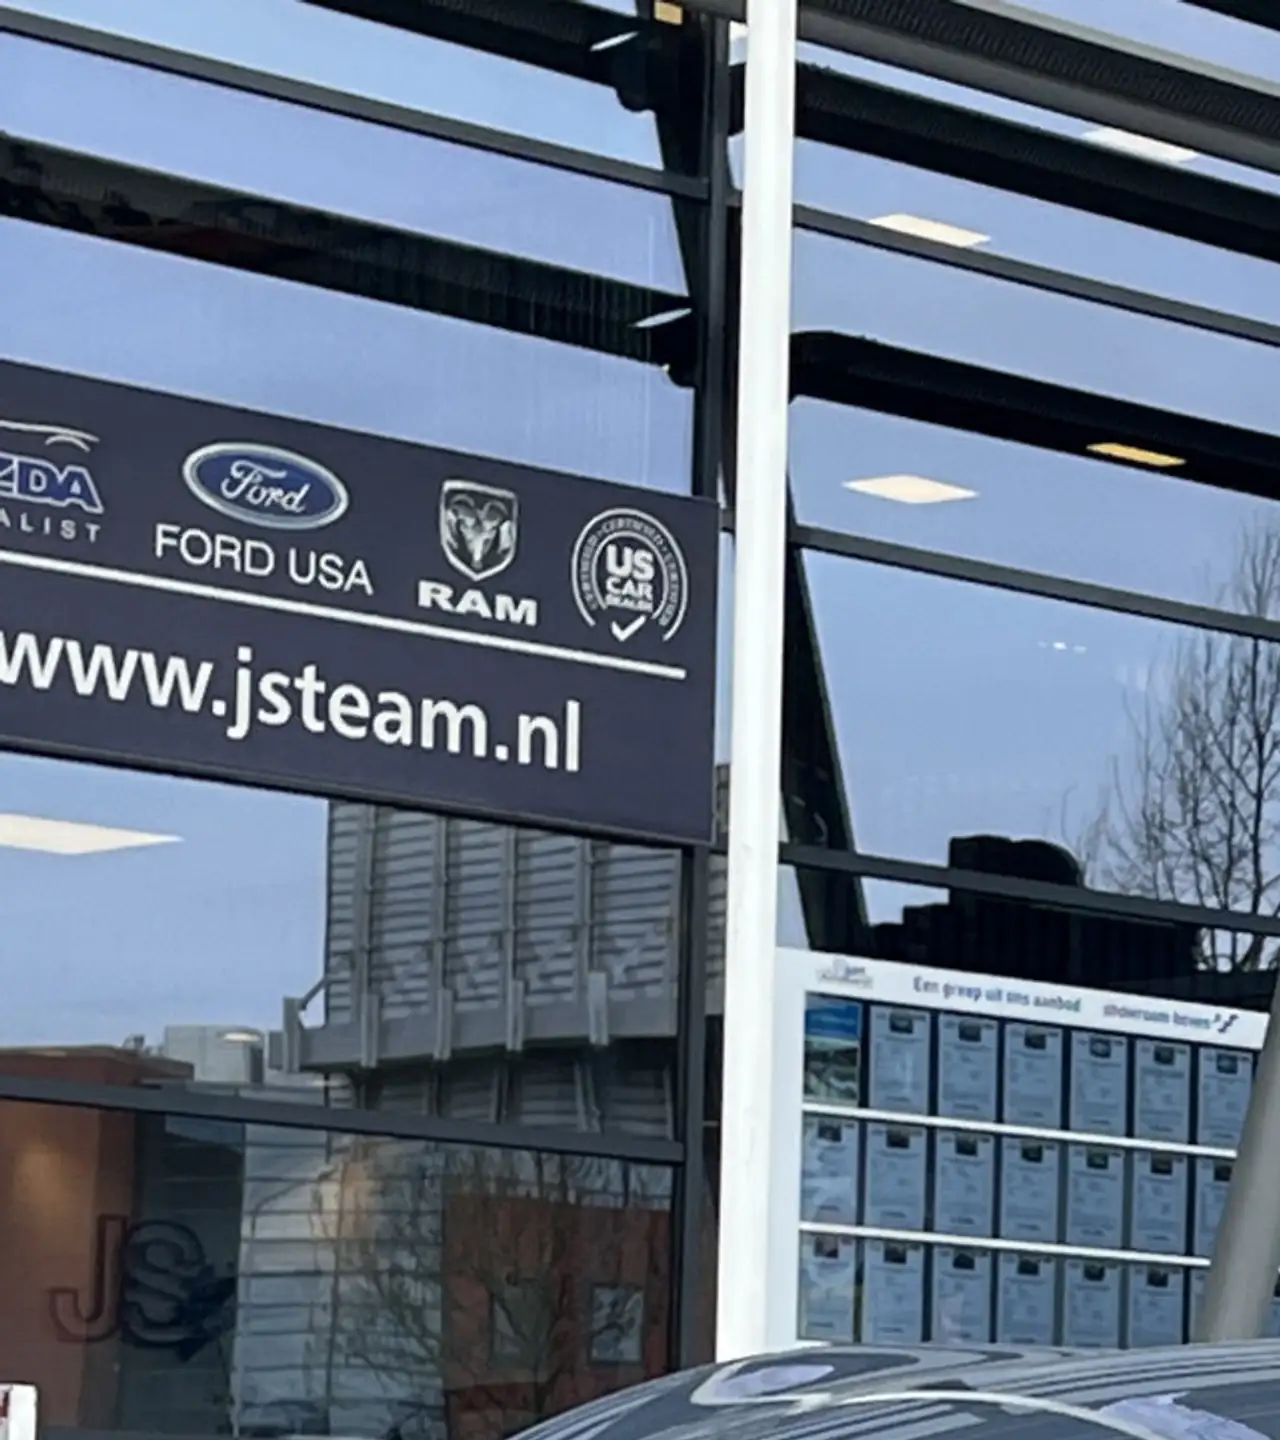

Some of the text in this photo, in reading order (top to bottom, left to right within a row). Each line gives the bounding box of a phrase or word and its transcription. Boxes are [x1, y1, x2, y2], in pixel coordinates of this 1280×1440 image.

[220, 459, 310, 514] Ford
[155, 523, 374, 596] FORD USA
[606, 543, 655, 580] US
[417, 580, 538, 626] RAM
[605, 576, 653, 601] CAR
[0, 631, 581, 772] www.jsteam.nl
